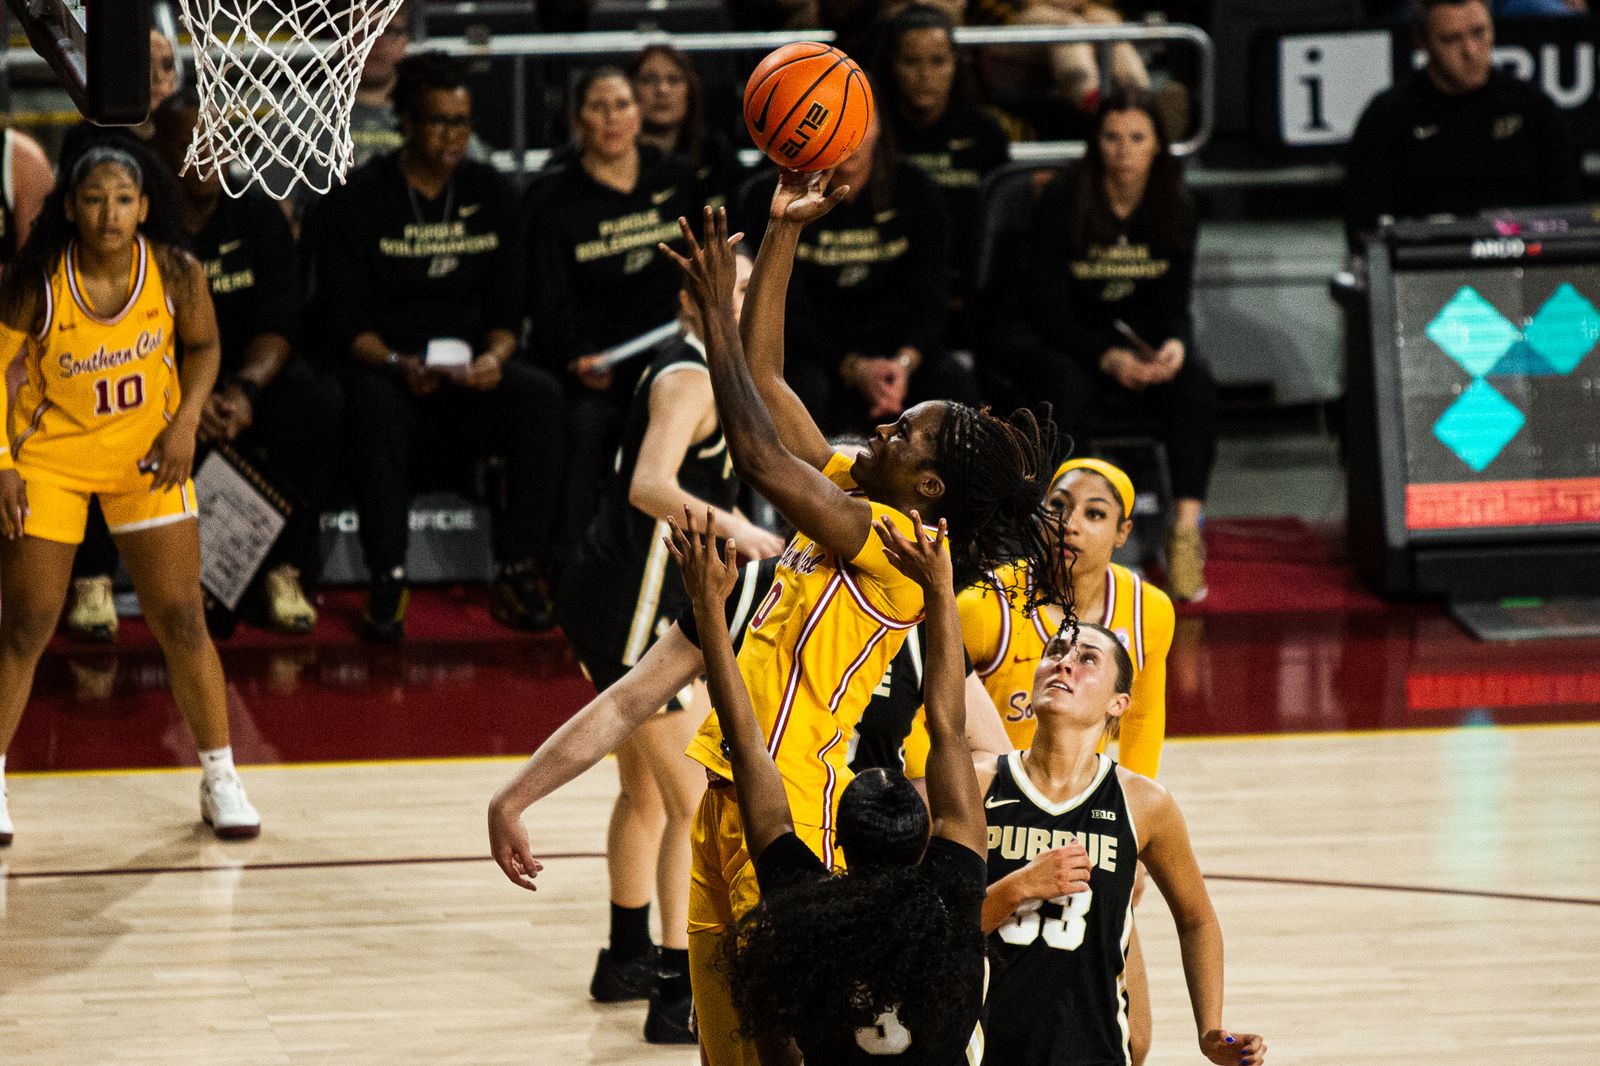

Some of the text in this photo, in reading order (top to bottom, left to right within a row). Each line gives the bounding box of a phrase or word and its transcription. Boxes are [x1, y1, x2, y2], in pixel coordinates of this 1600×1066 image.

[778, 100, 829, 160] ELITE
[58, 345, 133, 379] Southern
[94, 373, 145, 416] 10
